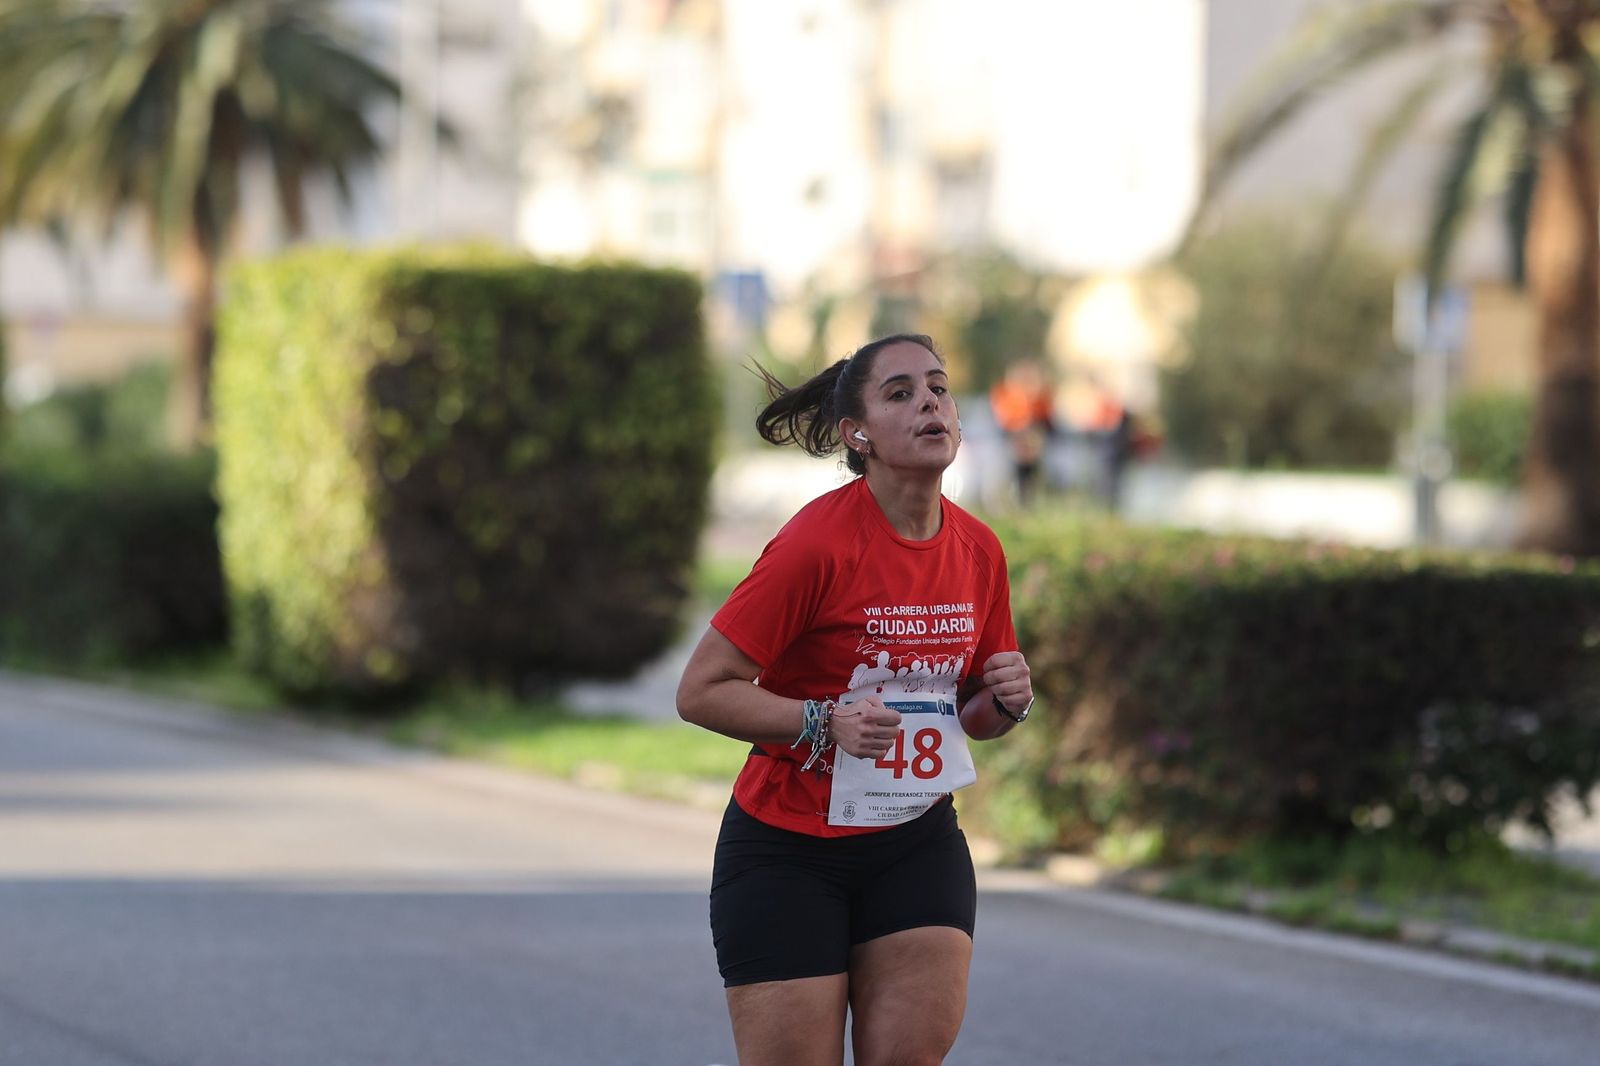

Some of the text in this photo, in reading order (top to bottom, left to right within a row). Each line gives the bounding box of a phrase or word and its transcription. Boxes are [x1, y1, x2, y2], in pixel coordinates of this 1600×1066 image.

[863, 603, 974, 616] VIII CARRERA URBANA DE
[866, 614, 975, 635] CIUDAD JARDÍN
[872, 635, 895, 645] Colegio
[922, 636, 940, 645] Unicaja
[941, 636, 961, 645] Sagrada
[875, 727, 943, 779] 48
